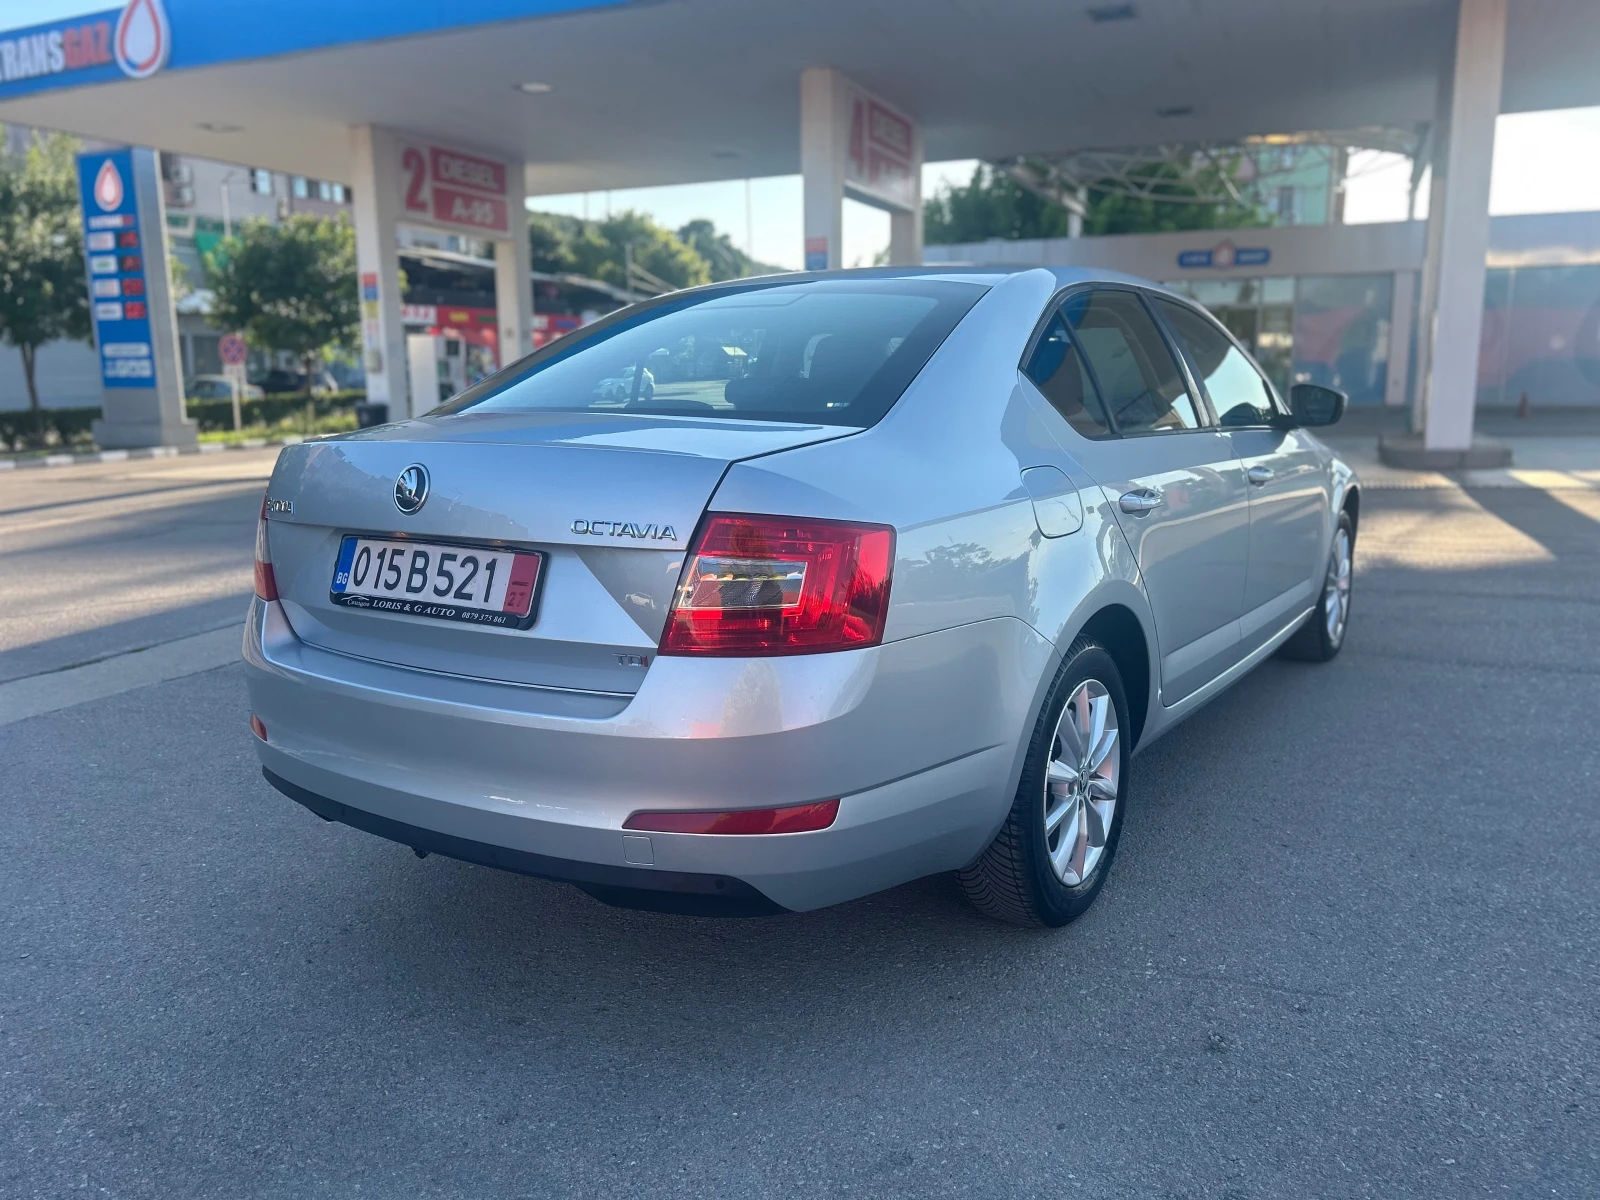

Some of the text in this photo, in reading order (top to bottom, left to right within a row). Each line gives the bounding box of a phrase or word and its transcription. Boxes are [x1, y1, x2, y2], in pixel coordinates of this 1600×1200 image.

[402, 147, 428, 213] 2
[437, 154, 500, 191] DIESEL
[570, 519, 678, 541] OCTAVIA
[336, 571, 349, 585] BG
[353, 546, 498, 603] 015B521
[507, 591, 526, 608] 27
[372, 600, 507, 624] LORIS & G AUTO 0879 375 861
[612, 653, 648, 668] TDI
